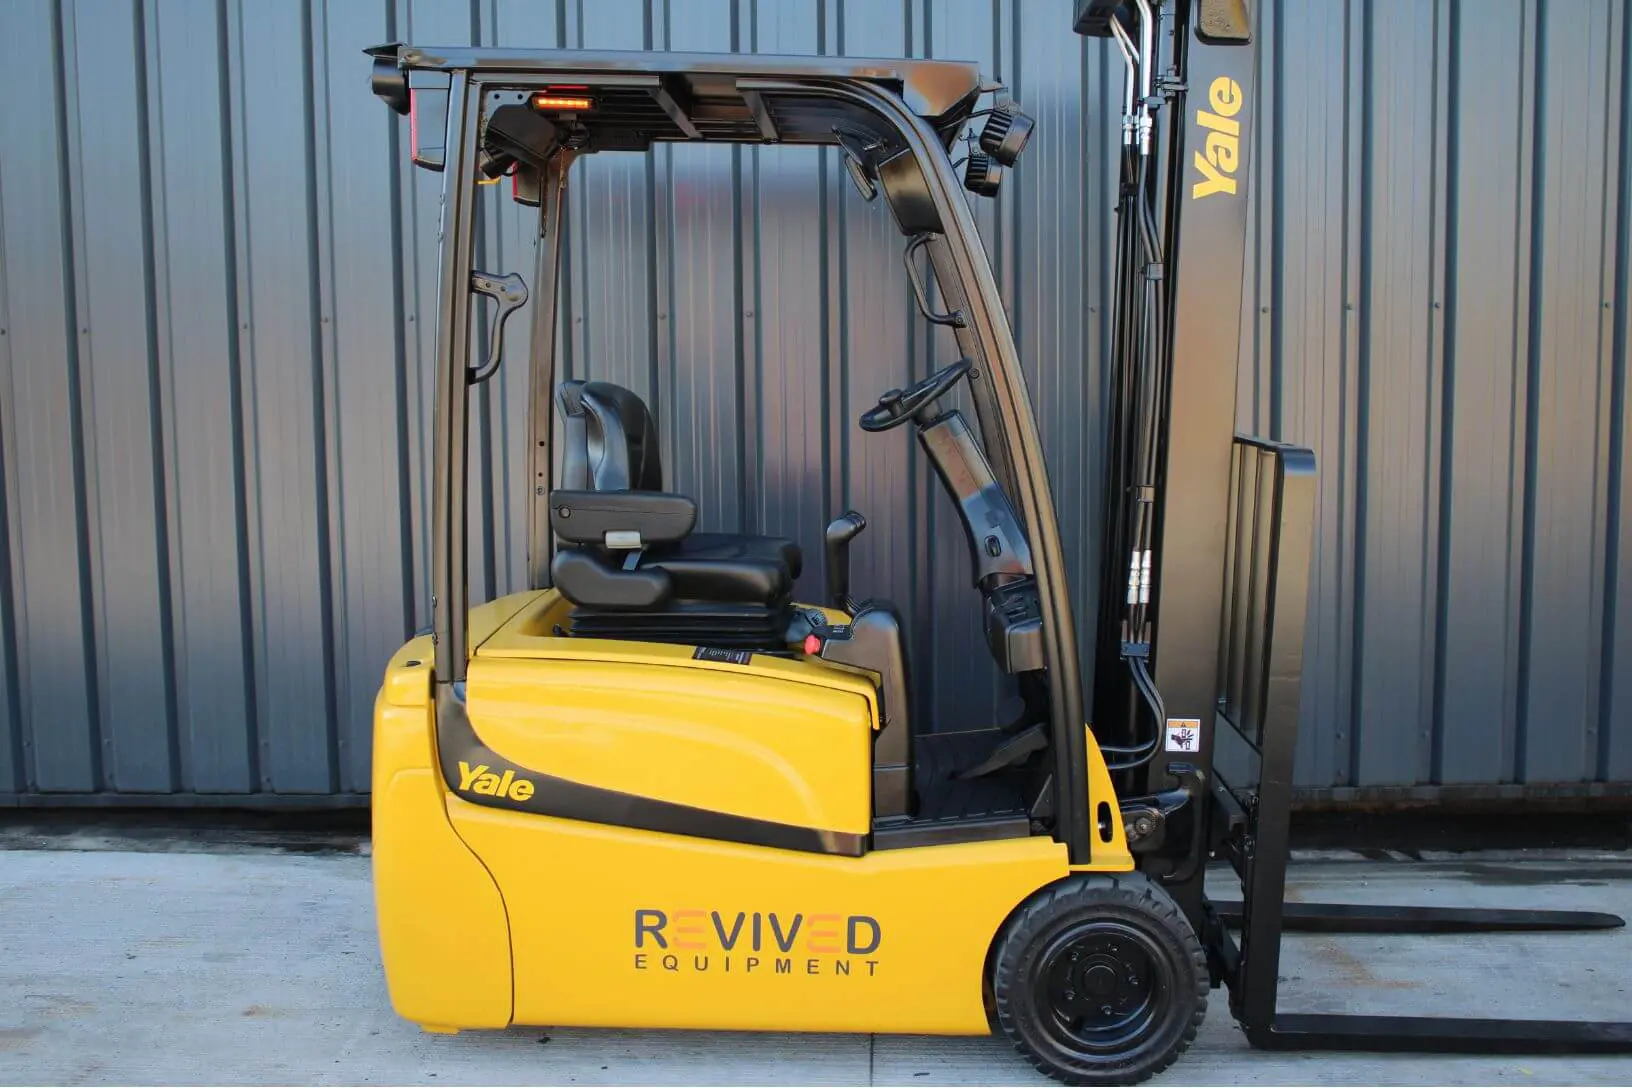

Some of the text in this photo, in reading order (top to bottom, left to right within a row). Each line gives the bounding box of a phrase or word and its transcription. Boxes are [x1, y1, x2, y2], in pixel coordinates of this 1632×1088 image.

[1192, 76, 1243, 199] Yale
[457, 761, 535, 802] Yale
[635, 909, 881, 955] REVIVED
[634, 953, 879, 977] EQUIPMENT
